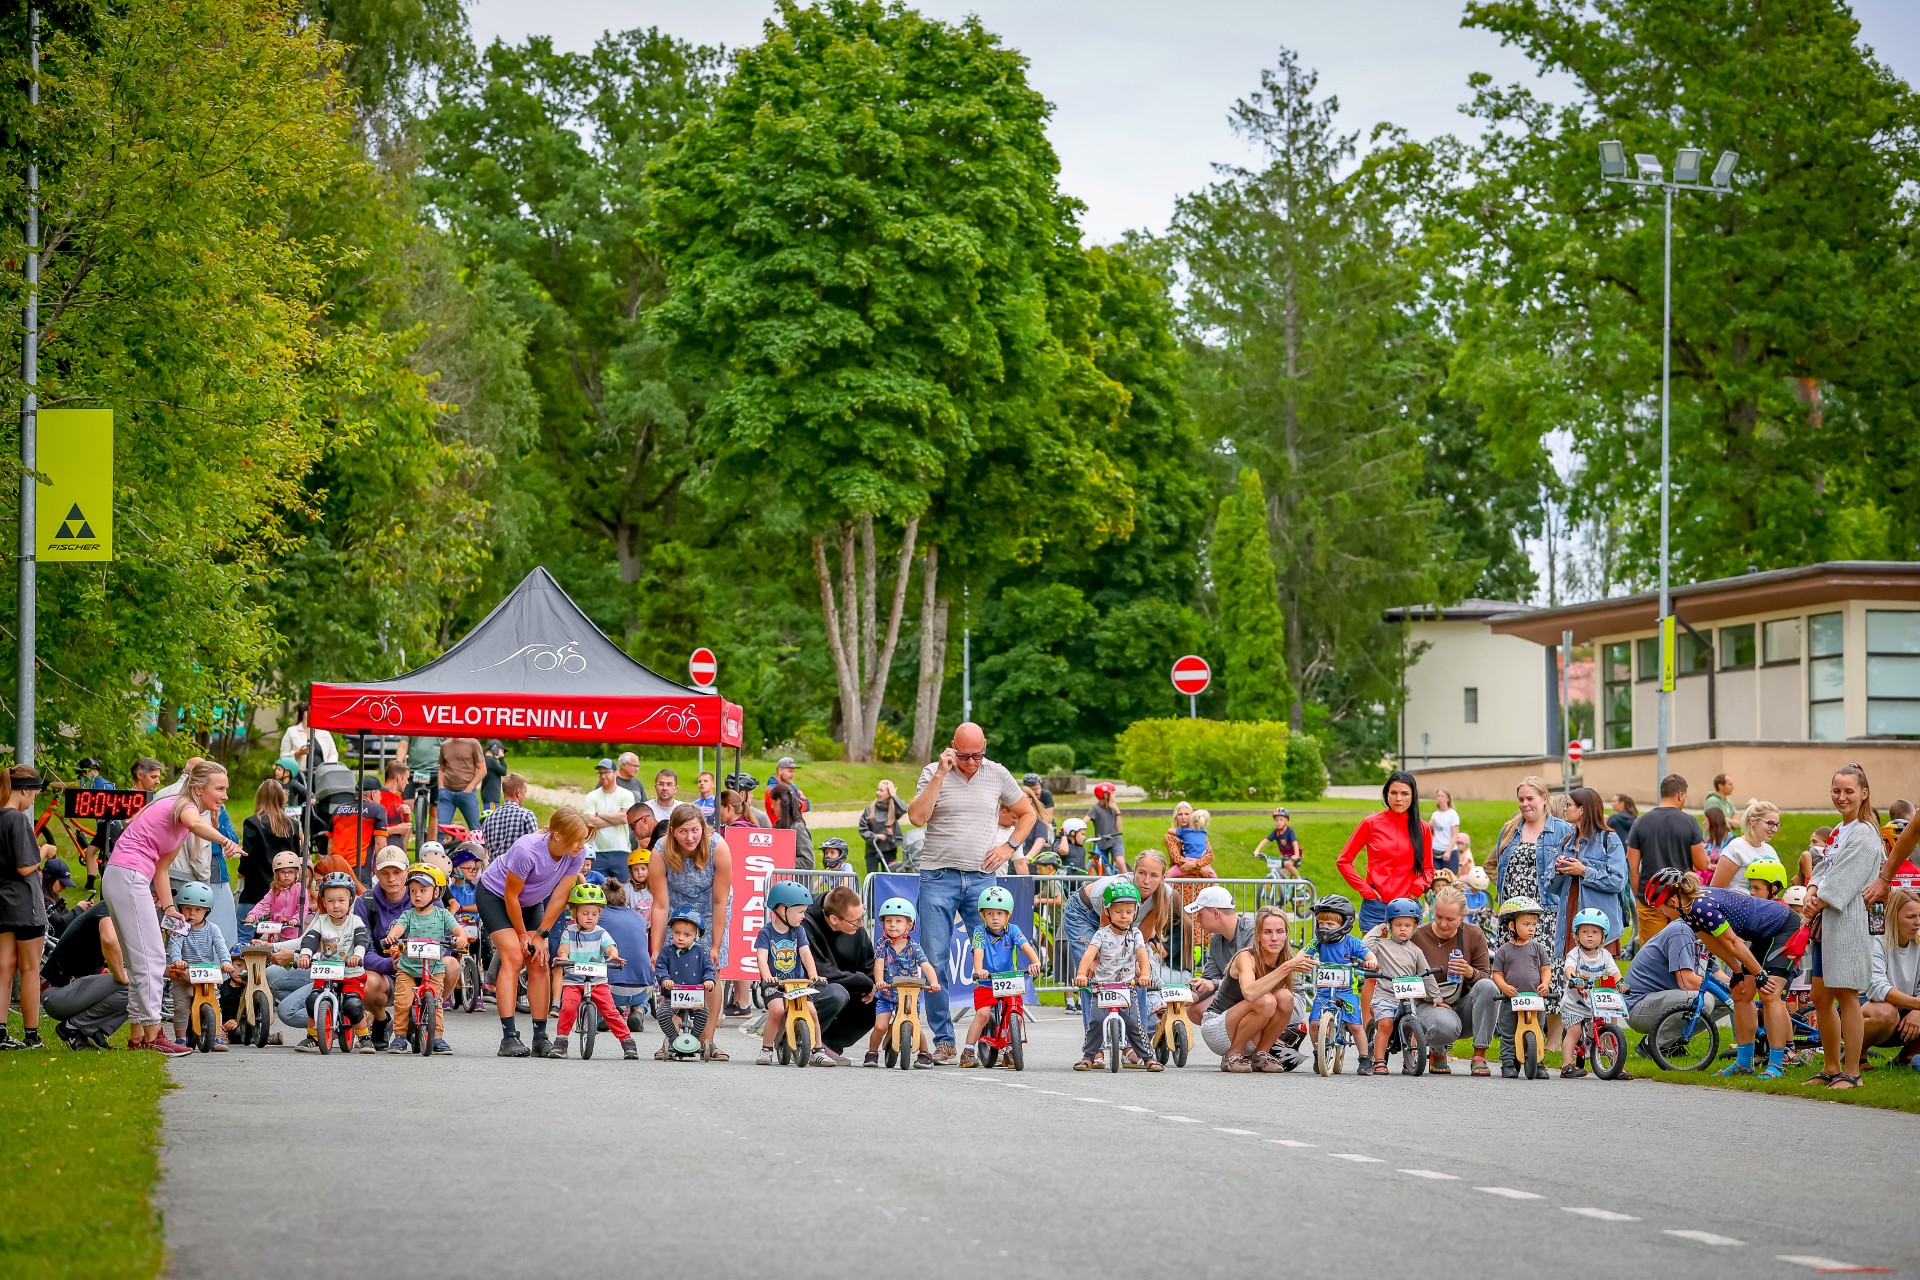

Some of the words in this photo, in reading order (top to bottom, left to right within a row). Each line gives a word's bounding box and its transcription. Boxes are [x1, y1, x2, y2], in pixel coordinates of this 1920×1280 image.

[421, 705, 609, 730] VELOTRENINI.LV
[75, 791, 145, 816] 18:04:49
[337, 807, 369, 815] SIGULA
[412, 944, 424, 952] 93
[190, 969, 209, 978] 373
[1318, 971, 1335, 981] 341
[993, 981, 1012, 991] 392
[1394, 984, 1413, 993] 364
[673, 993, 690, 1002] 194
[1100, 992, 1117, 1001] 108
[1162, 990, 1181, 998] 384
[1595, 994, 1612, 1003] 325
[1512, 998, 1531, 1006] 360
